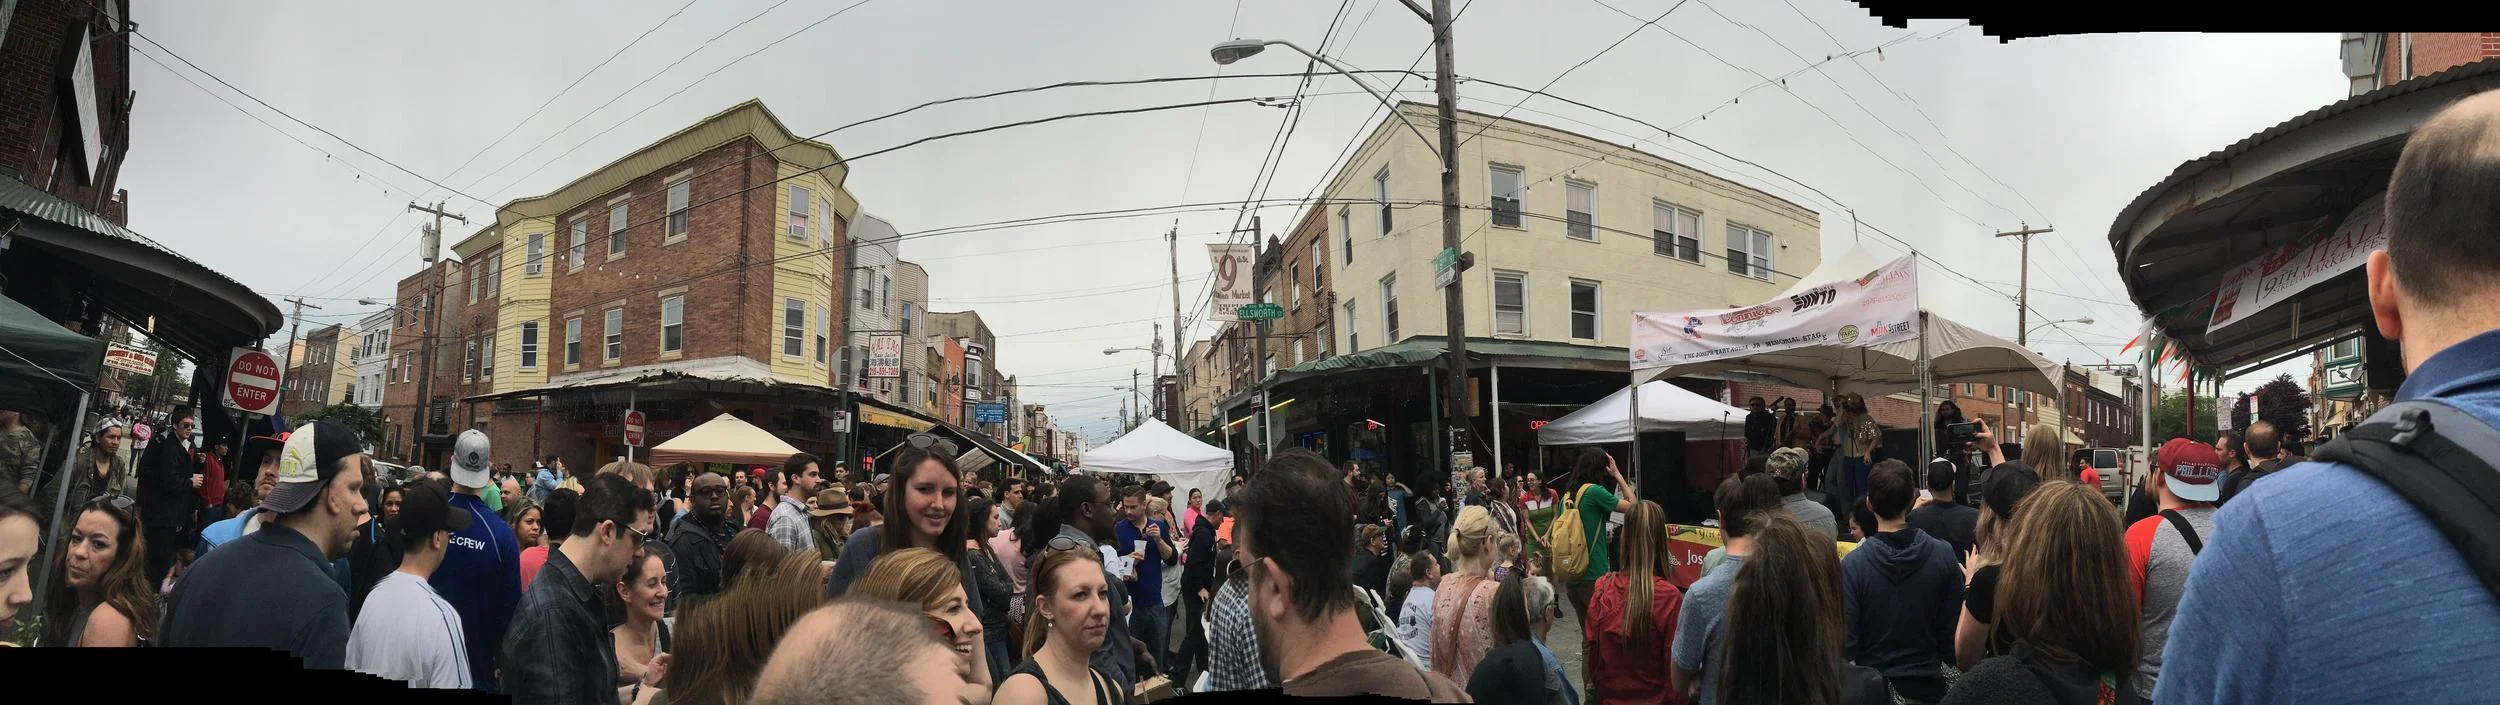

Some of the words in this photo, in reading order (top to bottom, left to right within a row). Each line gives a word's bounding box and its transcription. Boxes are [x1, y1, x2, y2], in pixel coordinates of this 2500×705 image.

[1219, 254, 1238, 292] 9
[2300, 248, 2356, 282] MARKET
[2272, 279, 2301, 295] STREET
[1239, 308, 1276, 318] ELLSWORTH
[1684, 352, 1694, 360] THE
[1765, 335, 1800, 348] MEMORIAL
[239, 360, 252, 372] DO
[255, 364, 275, 377] NOT
[237, 387, 267, 401] ENTER
